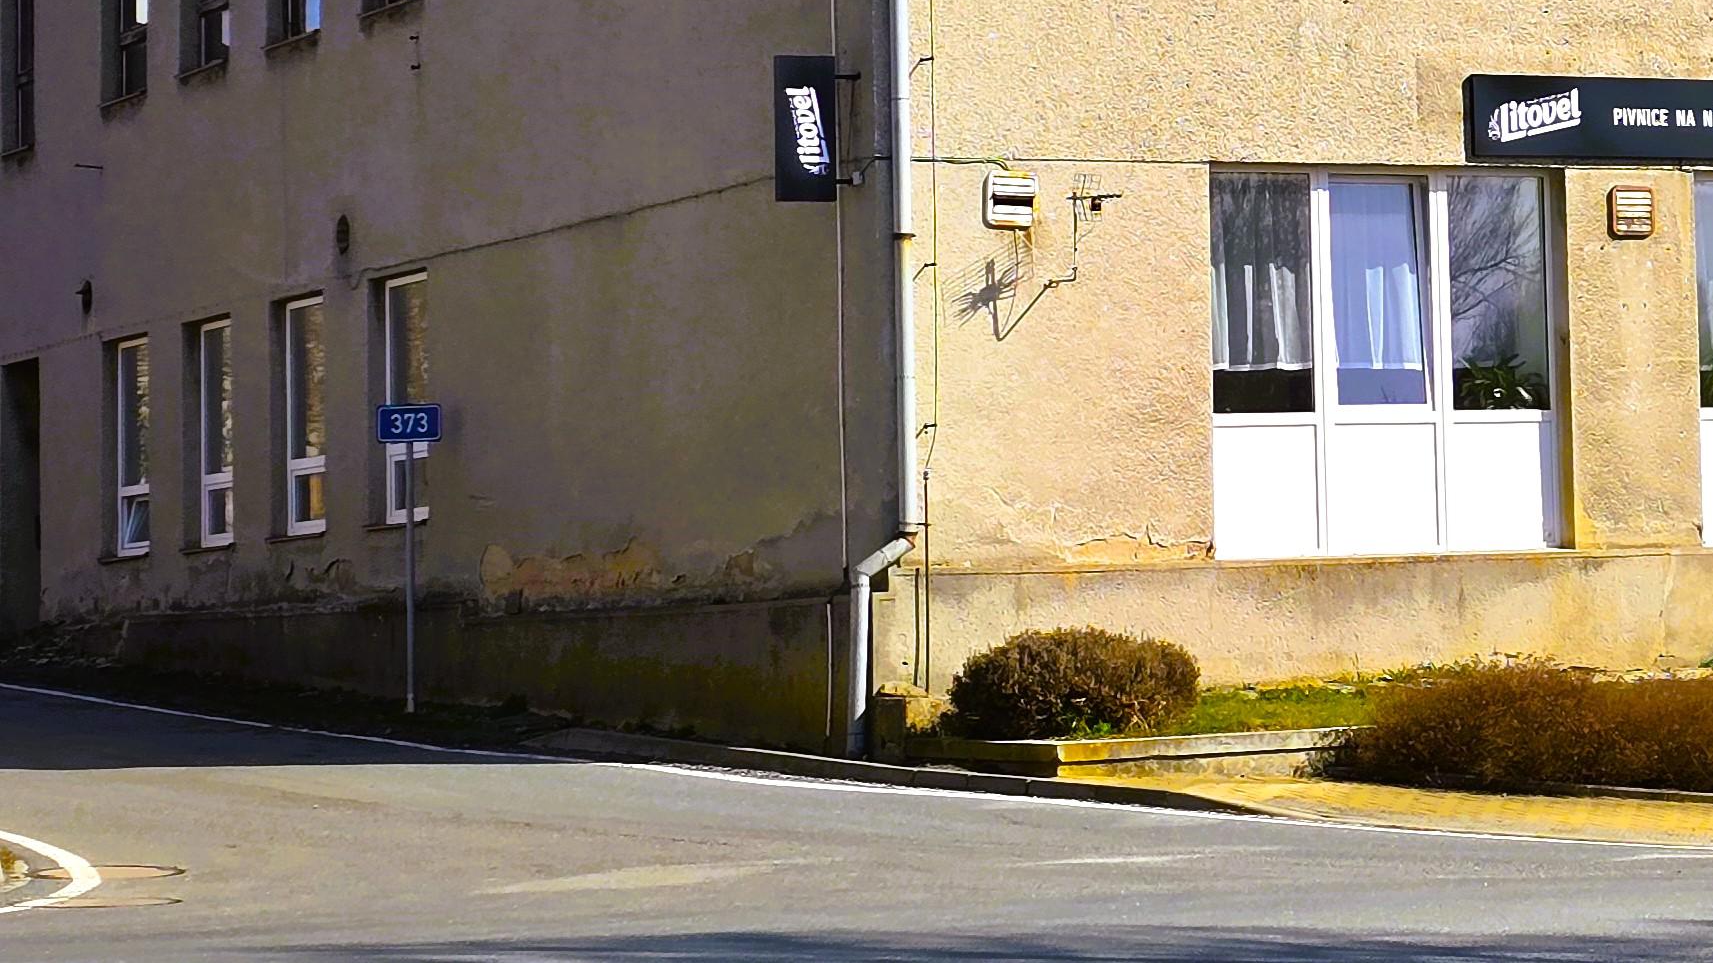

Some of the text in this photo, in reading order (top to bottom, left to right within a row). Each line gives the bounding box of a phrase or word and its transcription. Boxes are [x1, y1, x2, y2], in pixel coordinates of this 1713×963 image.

[785, 86, 830, 164] Litovel
[1500, 88, 1582, 143] Litovel
[1613, 107, 1669, 127] PIVNICE
[1675, 109, 1696, 127] NA
[390, 412, 429, 434] 373
